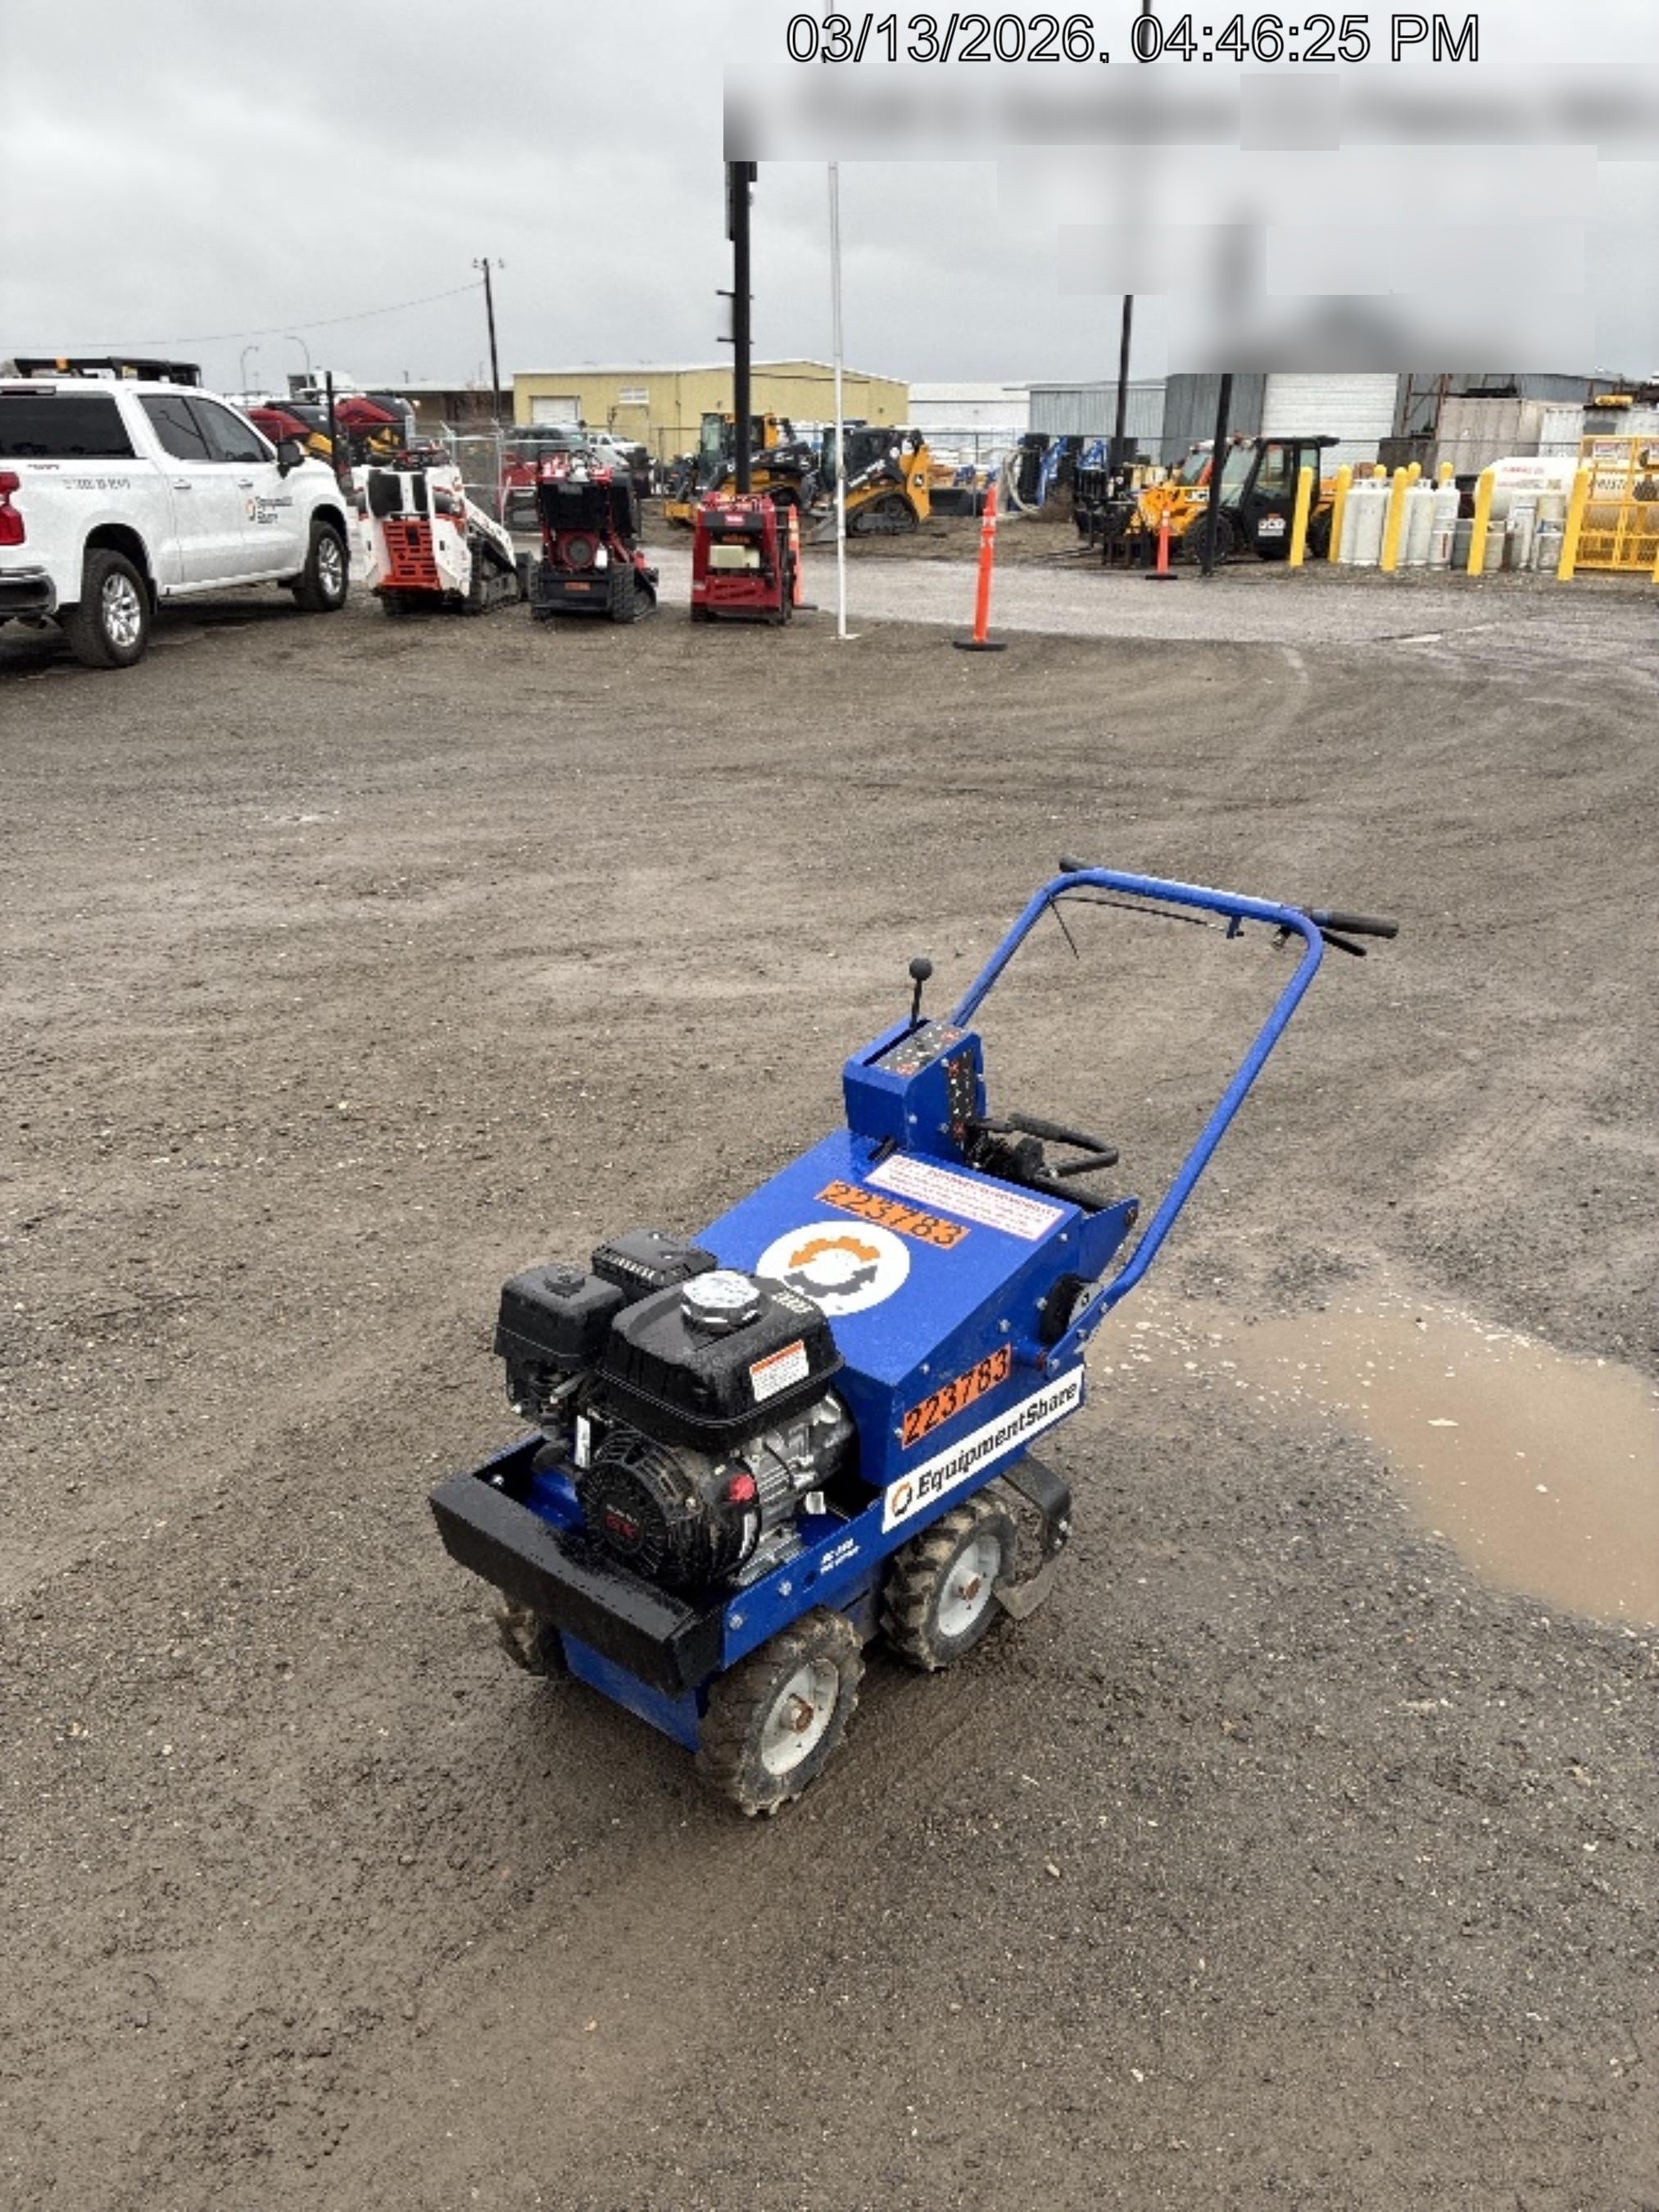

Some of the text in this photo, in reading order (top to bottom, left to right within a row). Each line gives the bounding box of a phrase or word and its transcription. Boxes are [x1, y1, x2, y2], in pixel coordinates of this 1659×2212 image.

[818, 1183, 962, 1245] 223783
[904, 1349, 1009, 1446] 223783
[916, 1381, 1078, 1501] EquipmentShare
